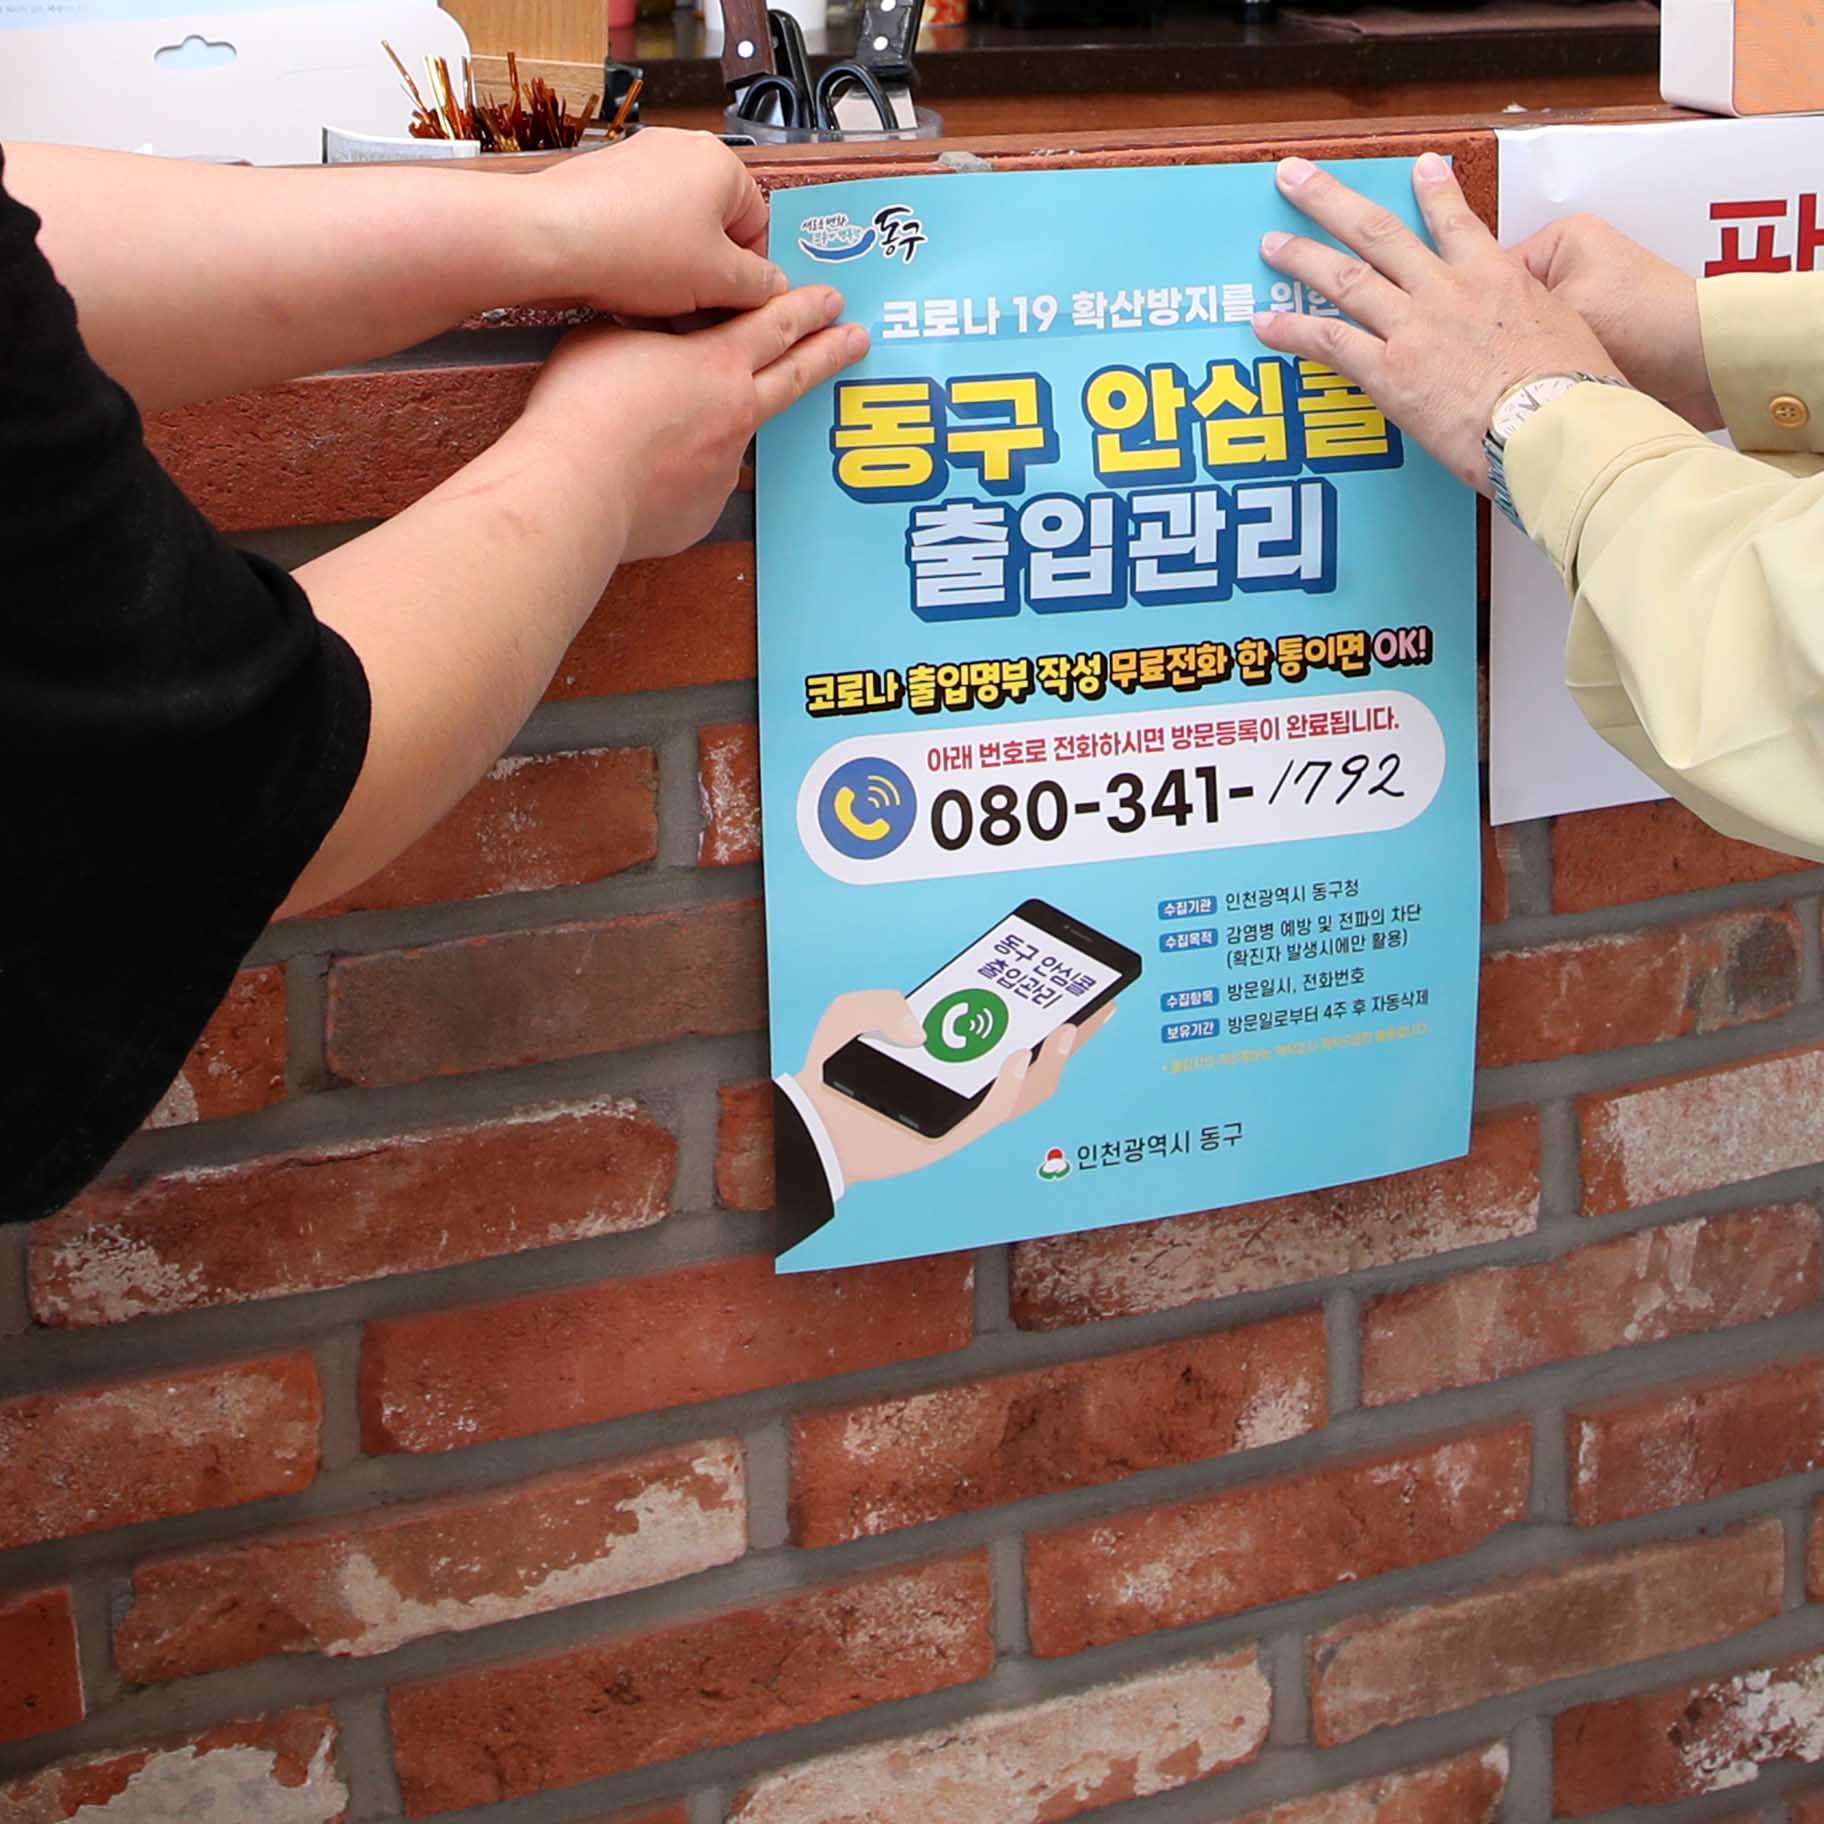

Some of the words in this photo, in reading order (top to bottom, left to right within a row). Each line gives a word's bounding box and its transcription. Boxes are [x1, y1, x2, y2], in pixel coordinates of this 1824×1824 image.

[874, 206, 926, 262] 동구
[882, 297, 1001, 339] 코로나
[1013, 294, 1058, 334] 19
[1072, 282, 1255, 330] 확산방지를
[833, 376, 1046, 490] 동구
[1085, 360, 1390, 474] 안심콜
[910, 480, 1324, 609] 출입관리
[805, 674, 900, 714] 코로나
[907, 663, 1030, 709] 출입명부
[1038, 654, 1104, 697] 작성
[1110, 644, 1230, 689] 무료전화
[1237, 638, 1270, 679] 한
[1277, 631, 1366, 675] 통이면
[1372, 628, 1428, 663] OK!
[927, 743, 973, 773] 아래
[979, 739, 1047, 769] 번호로
[1053, 727, 1166, 764] 전화하시면
[1170, 717, 1280, 753] 방문등록이
[1285, 707, 1401, 741] 완료됩니다.
[1164, 898, 1212, 918] 수집기관
[1225, 885, 1307, 912] 인천광역시
[1312, 879, 1360, 901] 동구청
[1165, 931, 1213, 950] 수집목적
[1226, 923, 1275, 945] 감염병
[1280, 918, 1312, 938] 예방
[1317, 915, 1334, 933] 및
[1339, 909, 1386, 932] 전파의
[1391, 903, 1422, 924] 차단
[1226, 946, 1282, 970] (확진자
[1287, 935, 1367, 962] 발생시에만
[1372, 927, 1409, 950] 활용)
[977, 958, 1064, 1010] 출입관리
[994, 934, 1040, 962] 동구
[1032, 956, 1097, 997] 안심콜
[1227, 977, 1297, 1003] 방문일시,
[1303, 966, 1366, 991] 전화번호
[1167, 1021, 1215, 1041] 보유기간
[1227, 1006, 1319, 1035] 방문일로부터
[1323, 1001, 1348, 1020] 4주
[1352, 997, 1367, 1016] 후
[1371, 988, 1430, 1013] 자동삭제
[1077, 1129, 1190, 1171] 인천광역시
[1199, 1122, 1244, 1152] 동구
